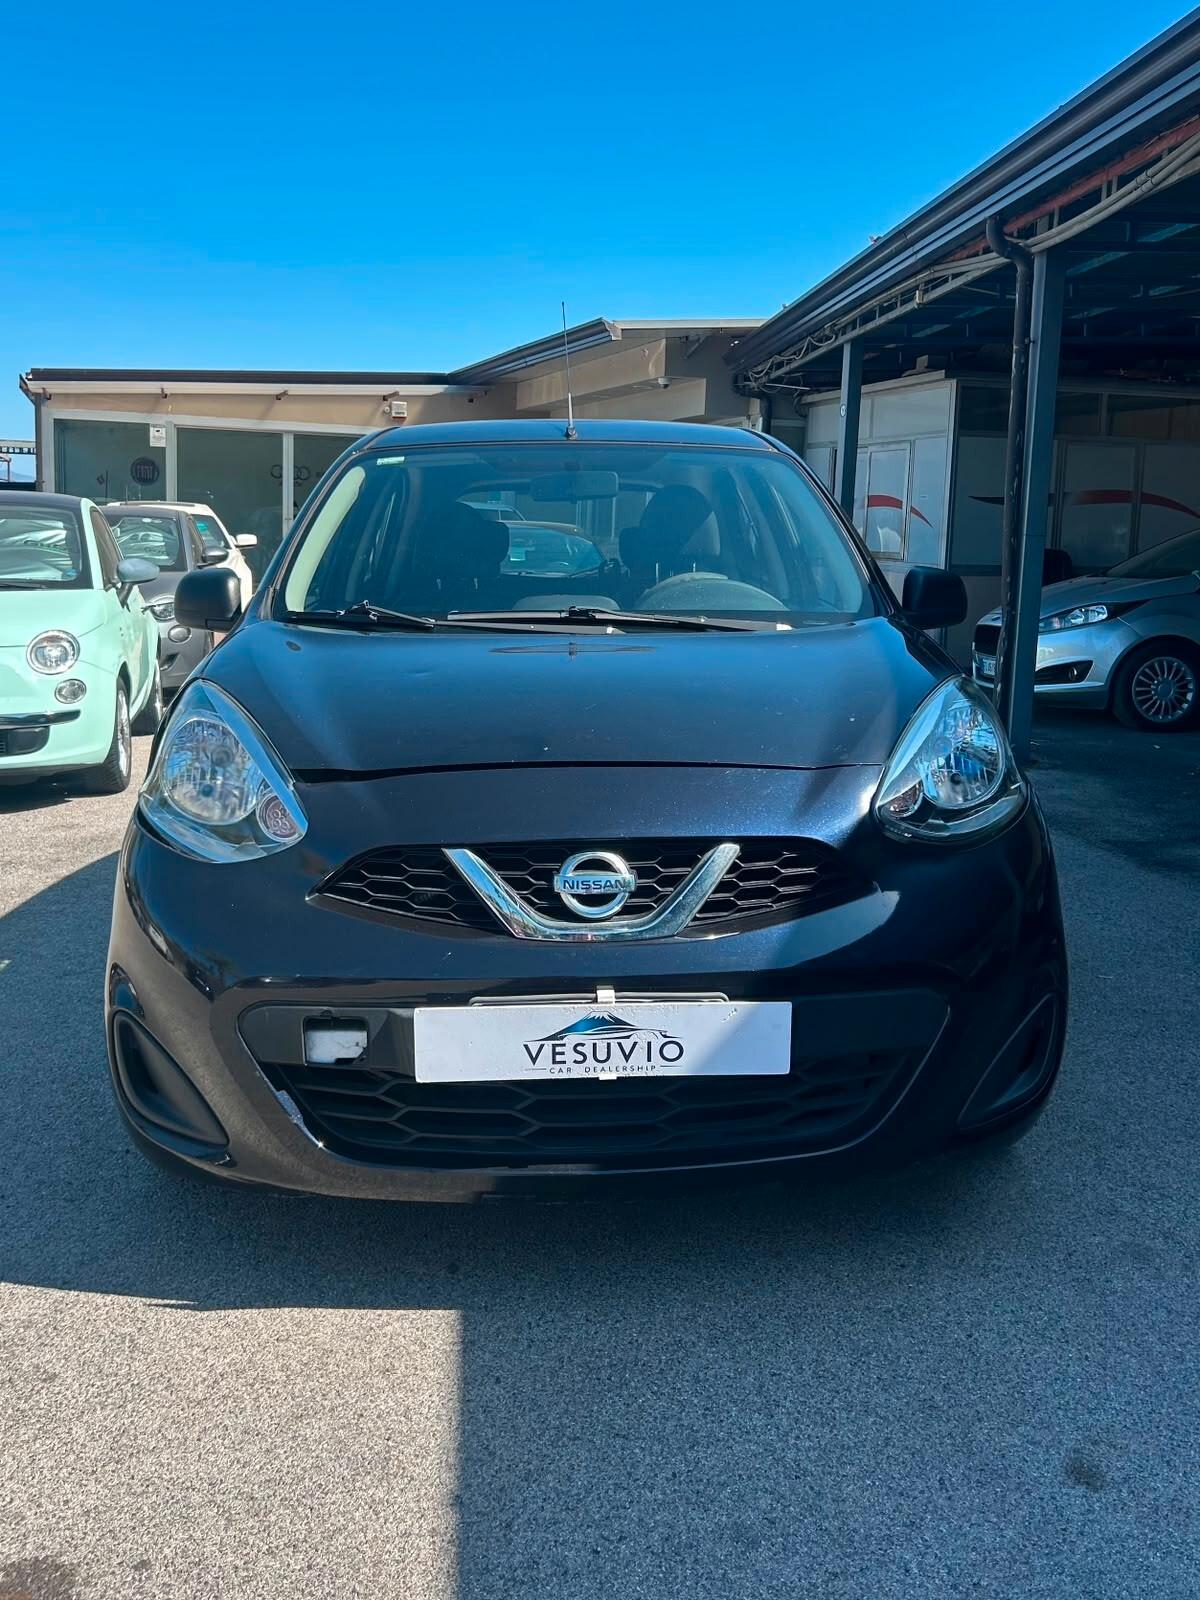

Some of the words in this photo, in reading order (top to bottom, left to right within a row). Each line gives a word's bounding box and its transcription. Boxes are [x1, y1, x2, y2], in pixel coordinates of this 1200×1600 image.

[562, 879, 626, 890] NISSAN
[522, 1040, 685, 1066] VESUVIO
[584, 1065, 656, 1074] DEALERSHIP
